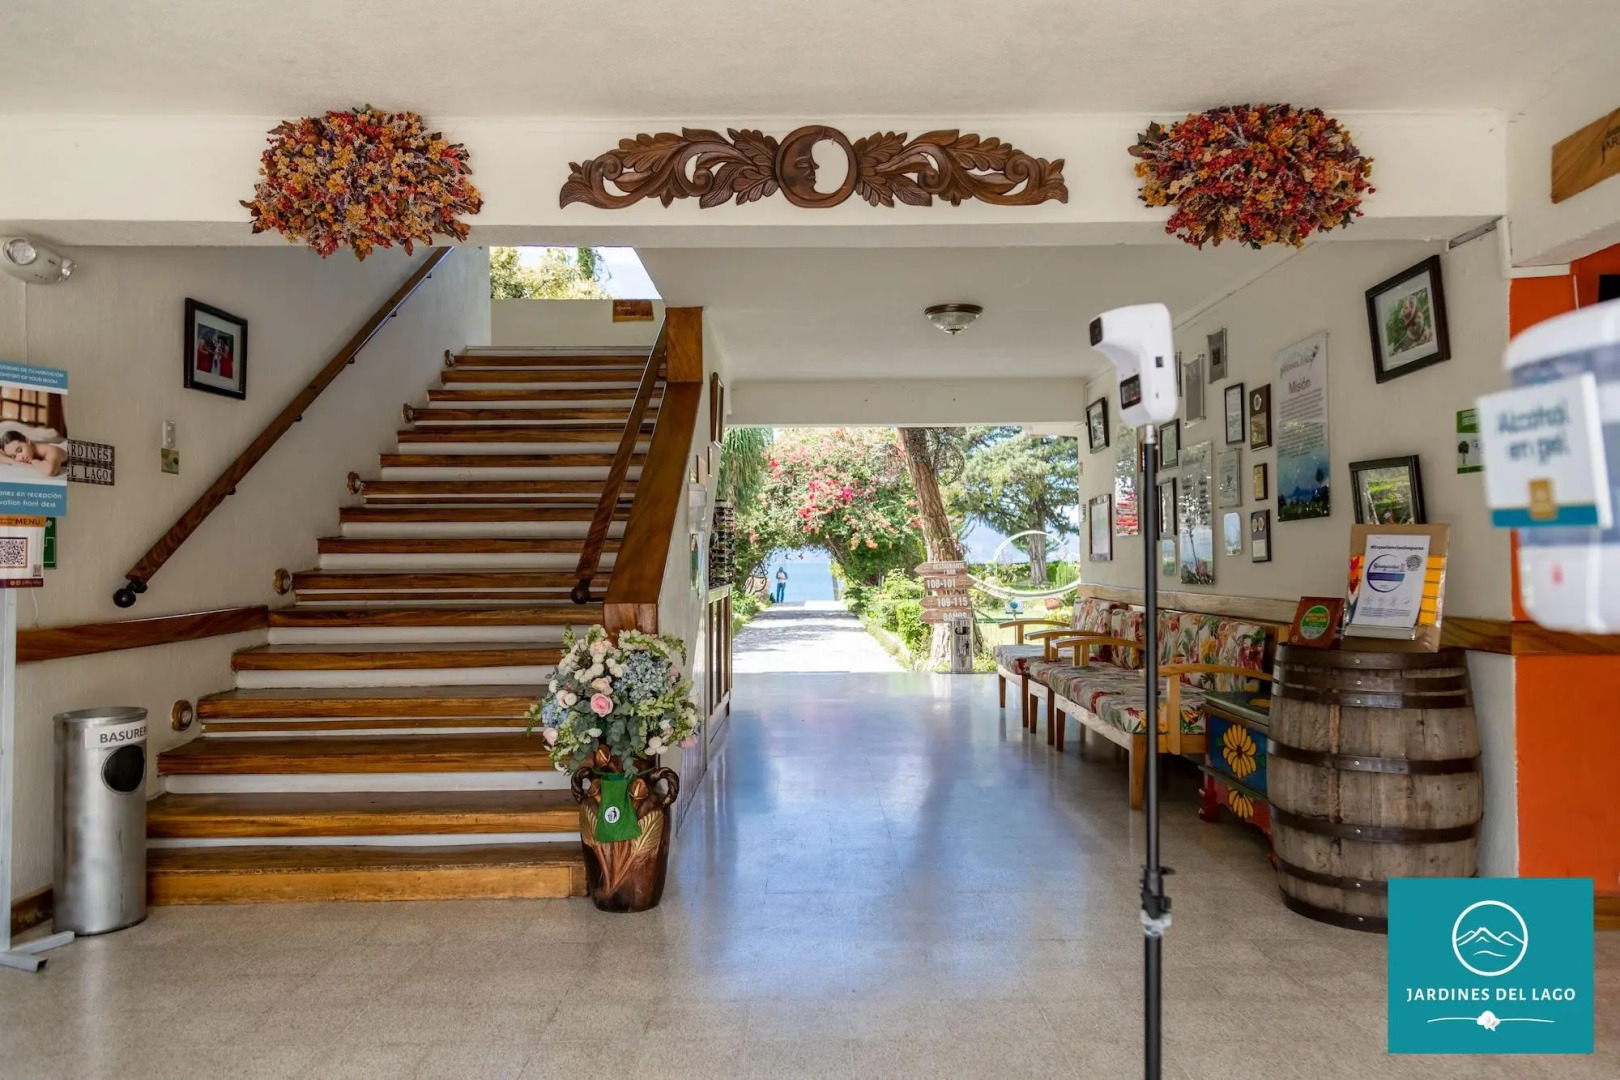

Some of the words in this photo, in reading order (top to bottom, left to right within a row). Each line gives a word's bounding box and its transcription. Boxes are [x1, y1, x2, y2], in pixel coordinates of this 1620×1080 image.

[84, 467, 109, 480] LAGO
[27, 491, 62, 499] recepción
[938, 597, 967, 606] 109-115
